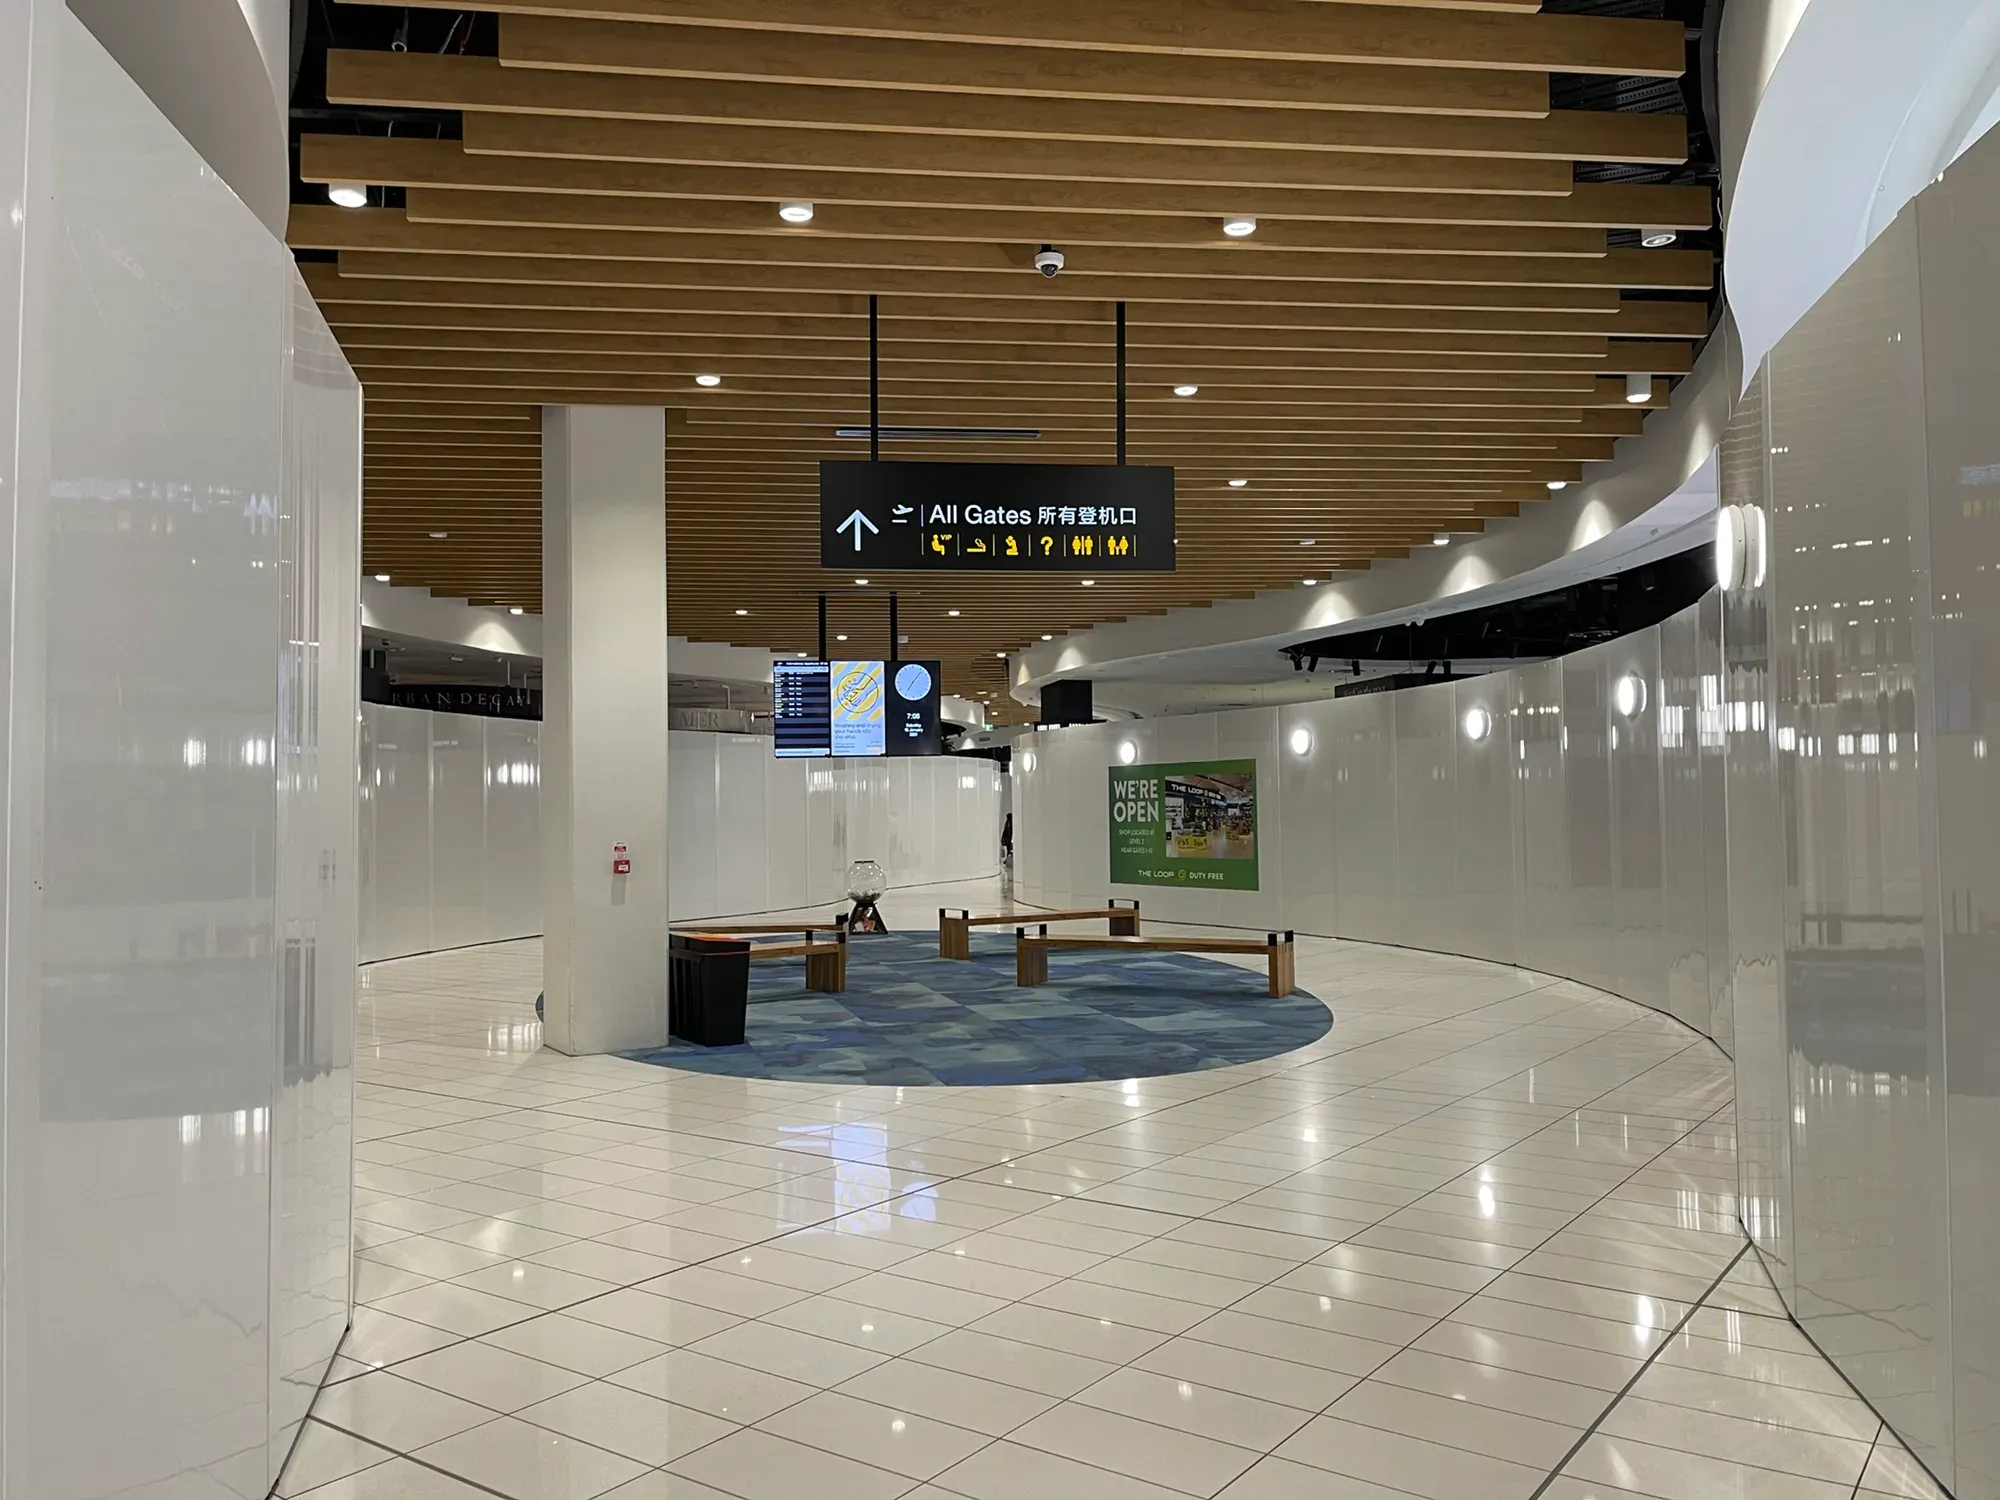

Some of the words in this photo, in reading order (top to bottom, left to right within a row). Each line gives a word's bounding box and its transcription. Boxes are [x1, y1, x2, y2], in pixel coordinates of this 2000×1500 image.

[929, 505, 957, 525] All
[964, 505, 1031, 525] Gates
[1038, 506, 1137, 526] 所有登机口
[391, 691, 451, 706] RBAN
[460, 692, 525, 707] DECAY
[1114, 779, 1158, 799] WE'RE
[1171, 784, 1186, 793] THE
[1188, 787, 1203, 795] LOOP
[1113, 801, 1159, 822] OPEN
[1153, 870, 1175, 878] LOOP
[1189, 872, 1206, 880] DUTY
